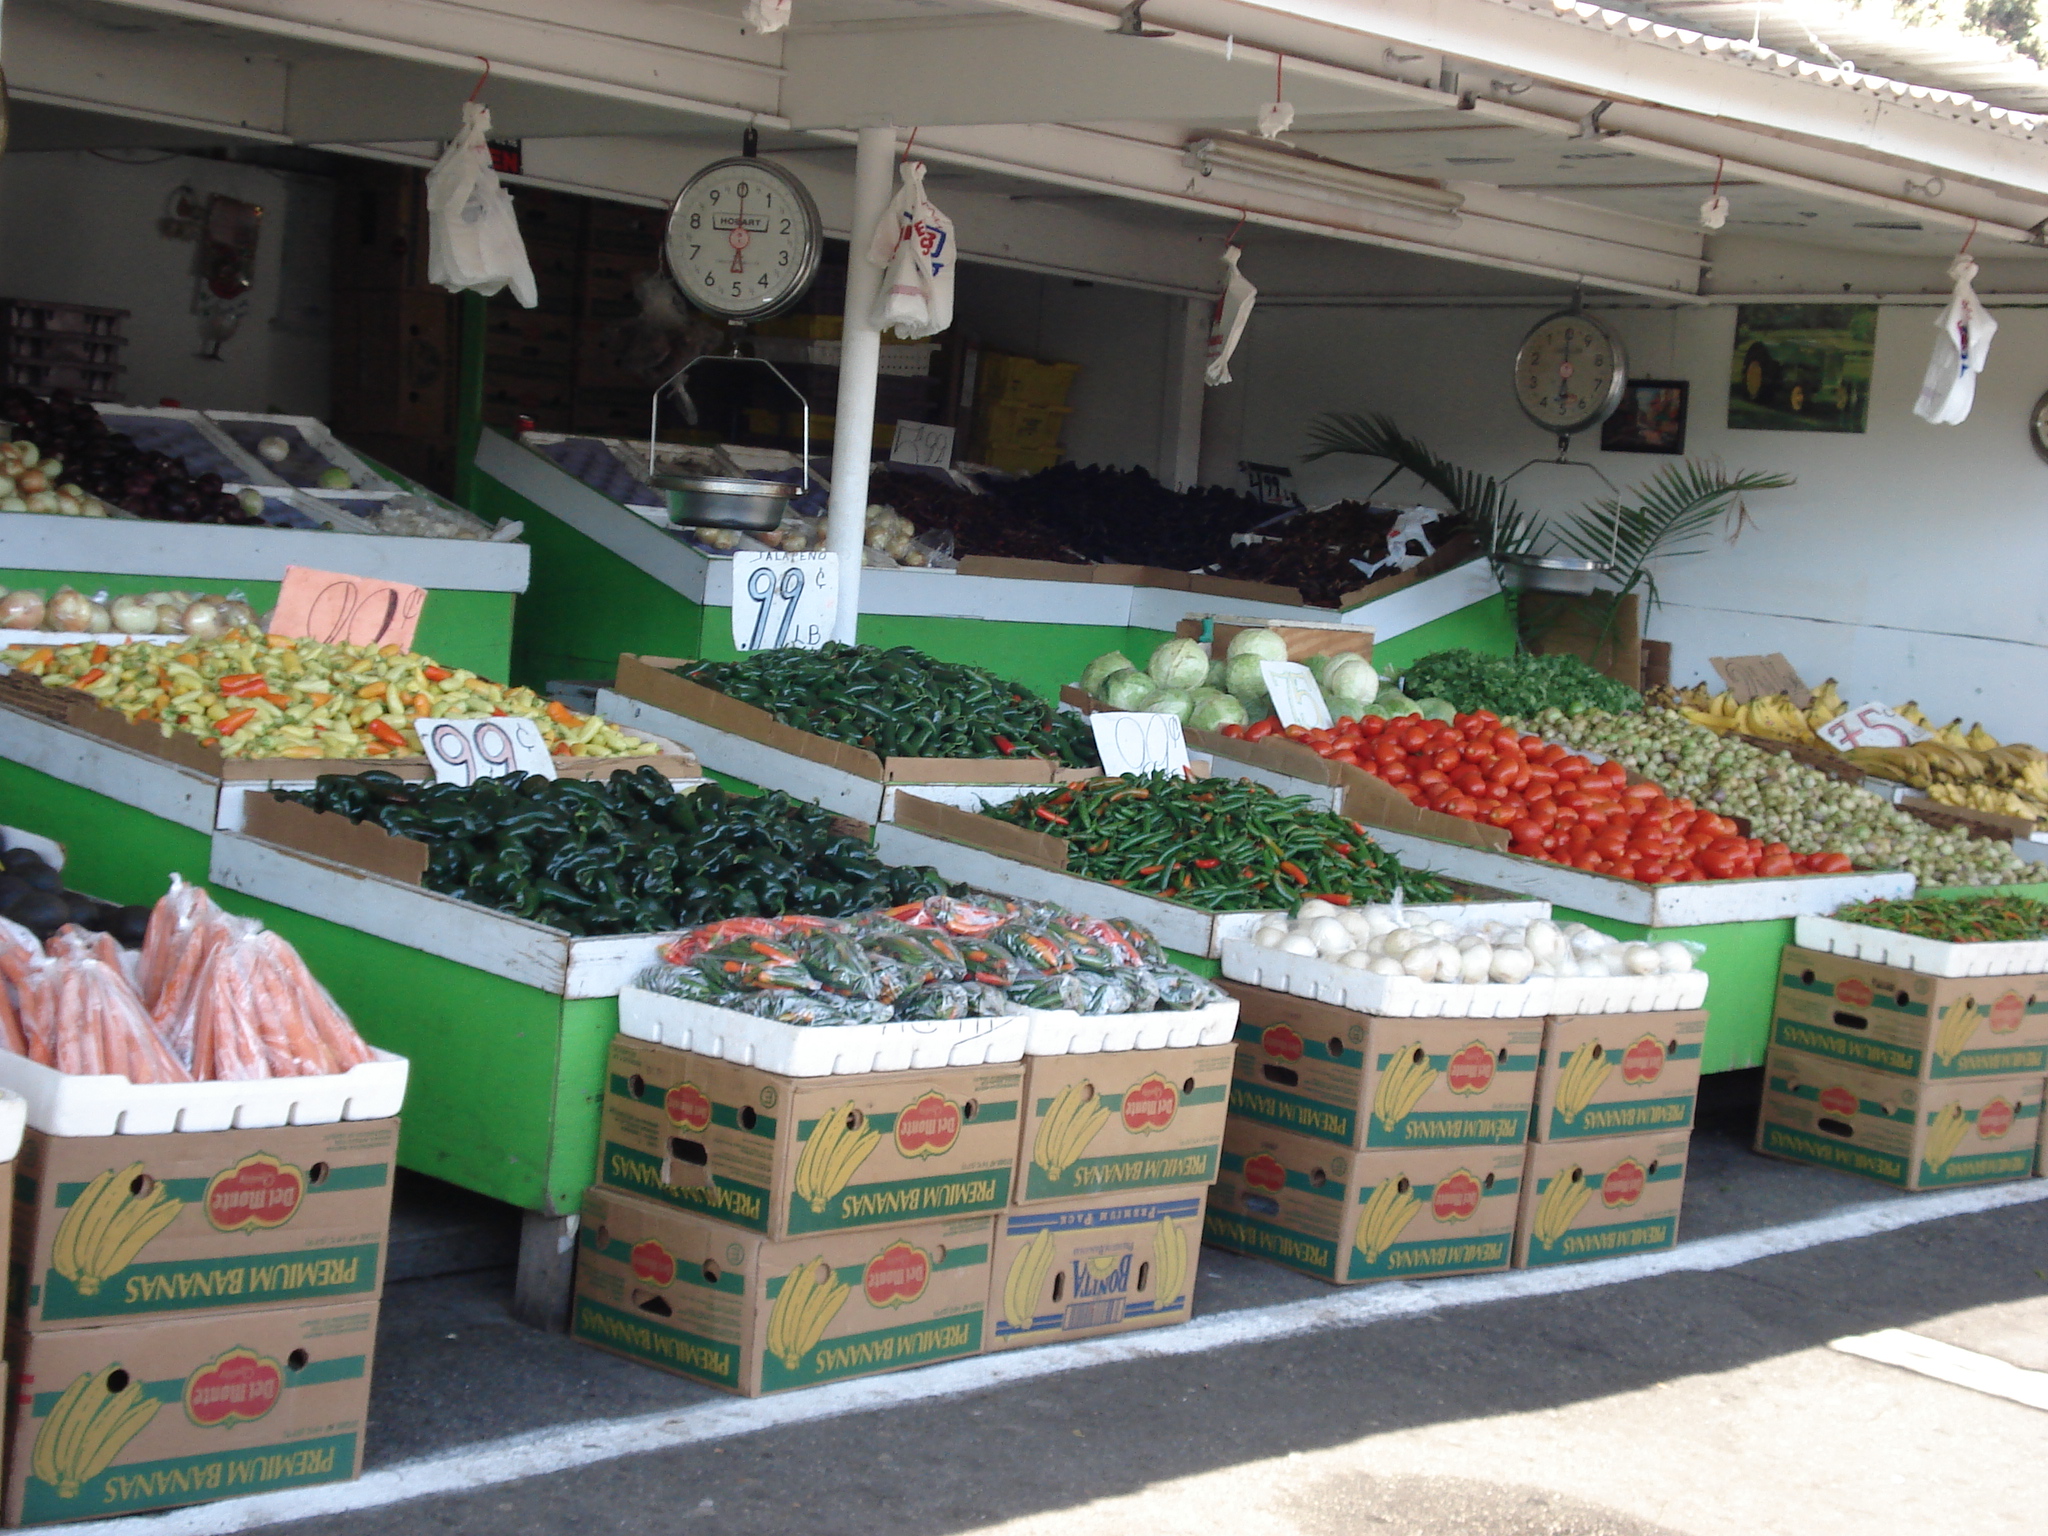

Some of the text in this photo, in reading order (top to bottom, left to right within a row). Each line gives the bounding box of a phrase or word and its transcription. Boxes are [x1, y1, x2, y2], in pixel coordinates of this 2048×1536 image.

[710, 190, 720, 206] 9
[737, 182, 749, 198] 0
[766, 193, 772, 208] 1
[690, 213, 701, 229] 8
[780, 219, 791, 234] 2
[690, 245, 701, 260] 7
[779, 251, 789, 266] 3
[705, 271, 715, 287] 6
[758, 273, 769, 289] 4
[731, 282, 741, 297] 5
[794, 624, 821, 645] LB
[1074, 1154, 1208, 1188] PREMIUM BANANAS
[841, 1179, 997, 1219] PREMIUM BANANAS
[125, 1257, 359, 1304] PREMIUM BANANAS
[1073, 1254, 1134, 1299] BONITA
[816, 1322, 971, 1374] PREMIUM BANANAS
[104, 1446, 336, 1504] PREMIUM BANANAS
